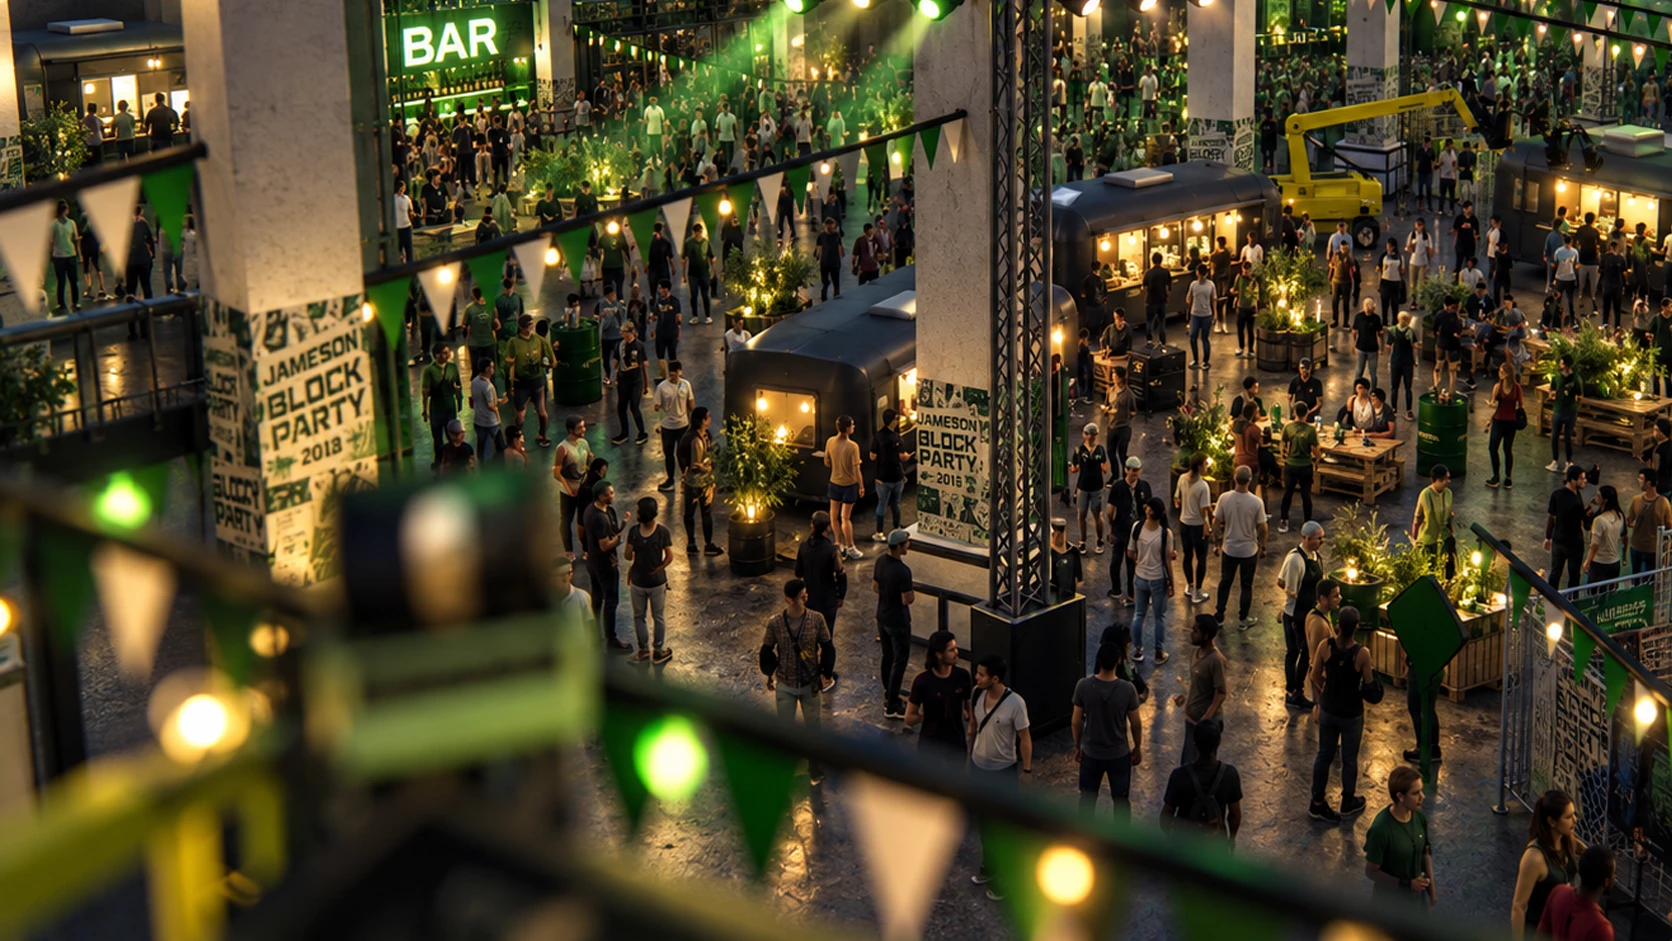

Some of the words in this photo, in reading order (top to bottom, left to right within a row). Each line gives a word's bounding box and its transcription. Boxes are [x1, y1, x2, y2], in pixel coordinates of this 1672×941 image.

[402, 17, 499, 67] BAR
[264, 328, 359, 386] JAMESON
[267, 357, 364, 420] BLOCK
[272, 387, 366, 450] PARTY
[918, 412, 977, 432] JAMESON
[919, 430, 977, 453] BLOCK
[919, 449, 978, 473] PARTY
[214, 502, 264, 537] PARTY
